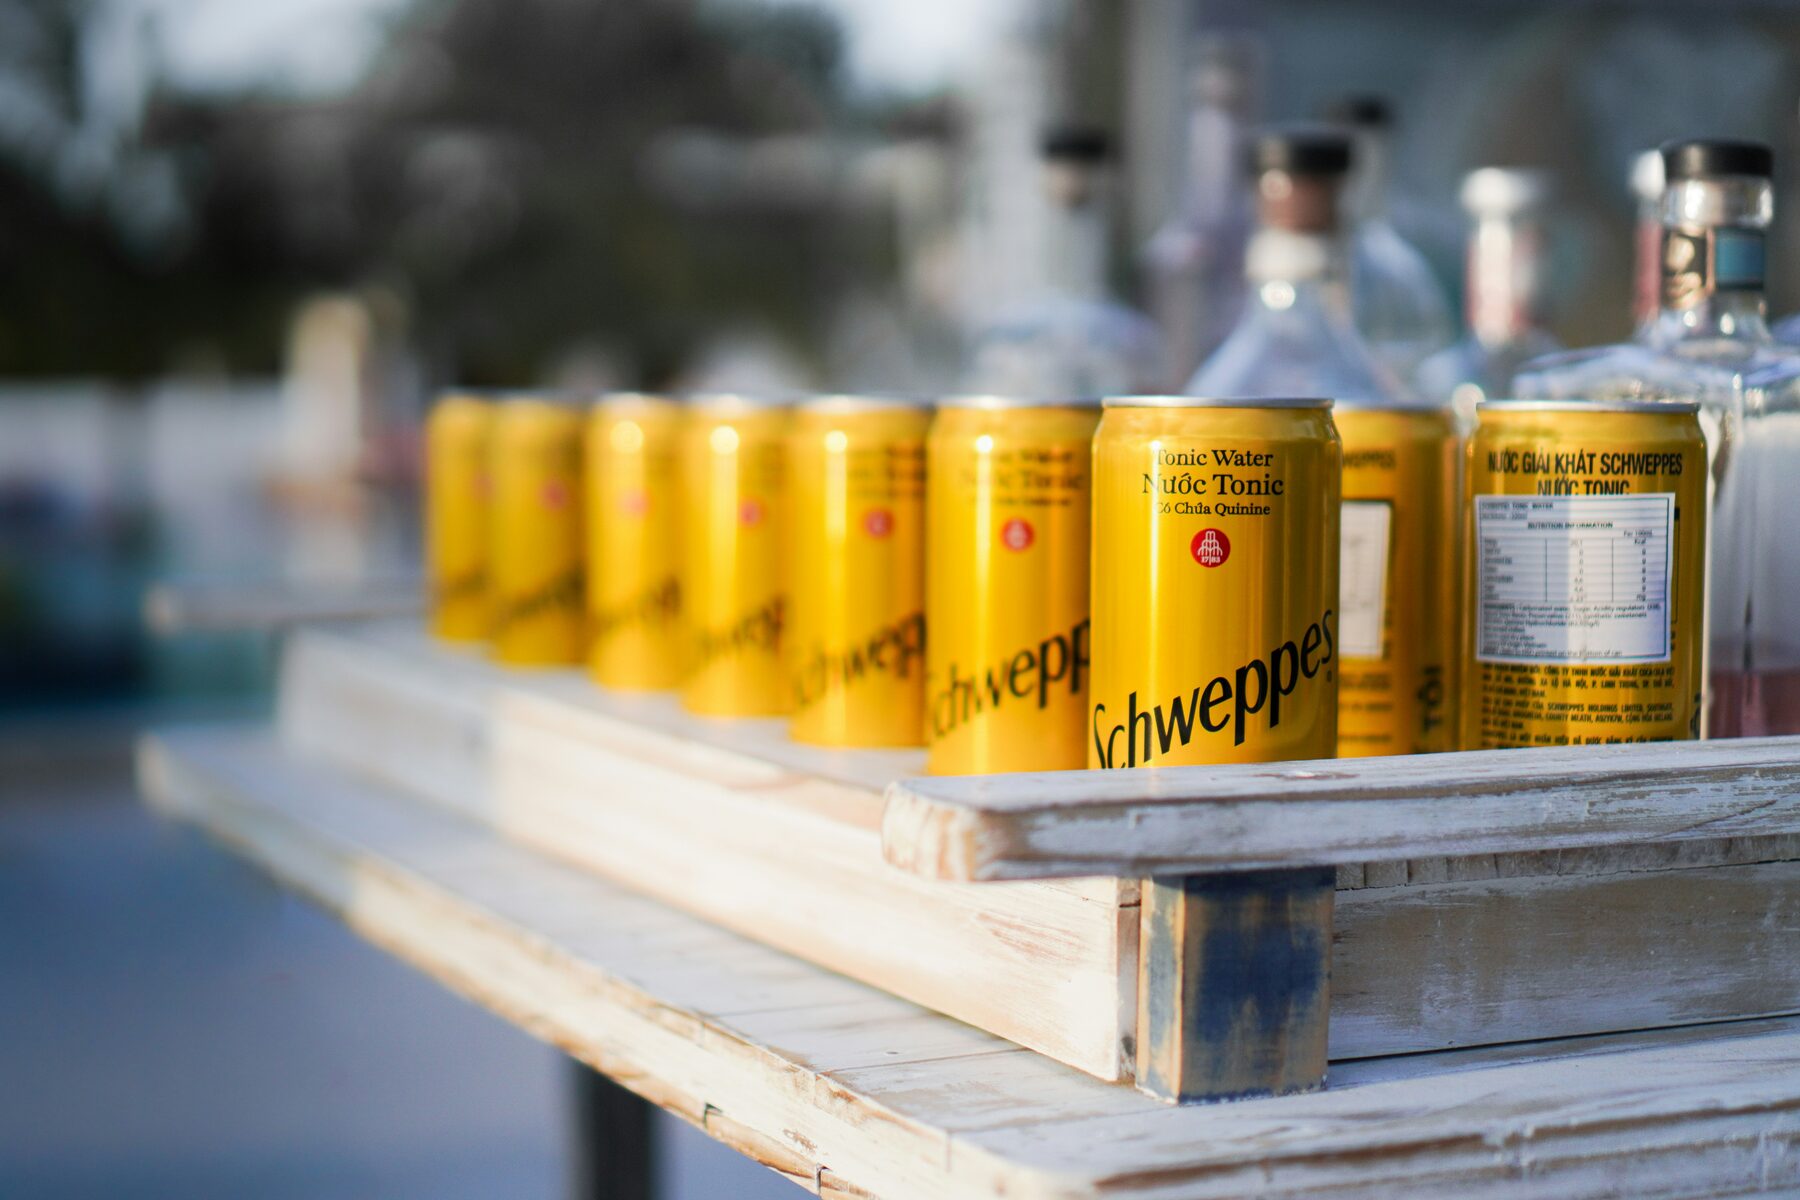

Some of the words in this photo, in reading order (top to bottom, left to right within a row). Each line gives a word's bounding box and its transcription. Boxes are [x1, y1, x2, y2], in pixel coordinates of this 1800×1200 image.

[1156, 449, 1208, 466] Tonic
[1211, 450, 1274, 467] Water
[1523, 447, 1550, 474] GIẢI
[1555, 448, 1596, 475] KHÁT
[1600, 452, 1683, 476] SCHWEPPES
[1142, 472, 1207, 495] Nước
[1212, 473, 1284, 495] Tonic
[1583, 480, 1630, 496] TONIC
[1156, 502, 1171, 515] Có
[1174, 502, 1210, 515] Chứa
[1215, 503, 1271, 517] Quinine
[1093, 609, 1334, 769] Schweppes
